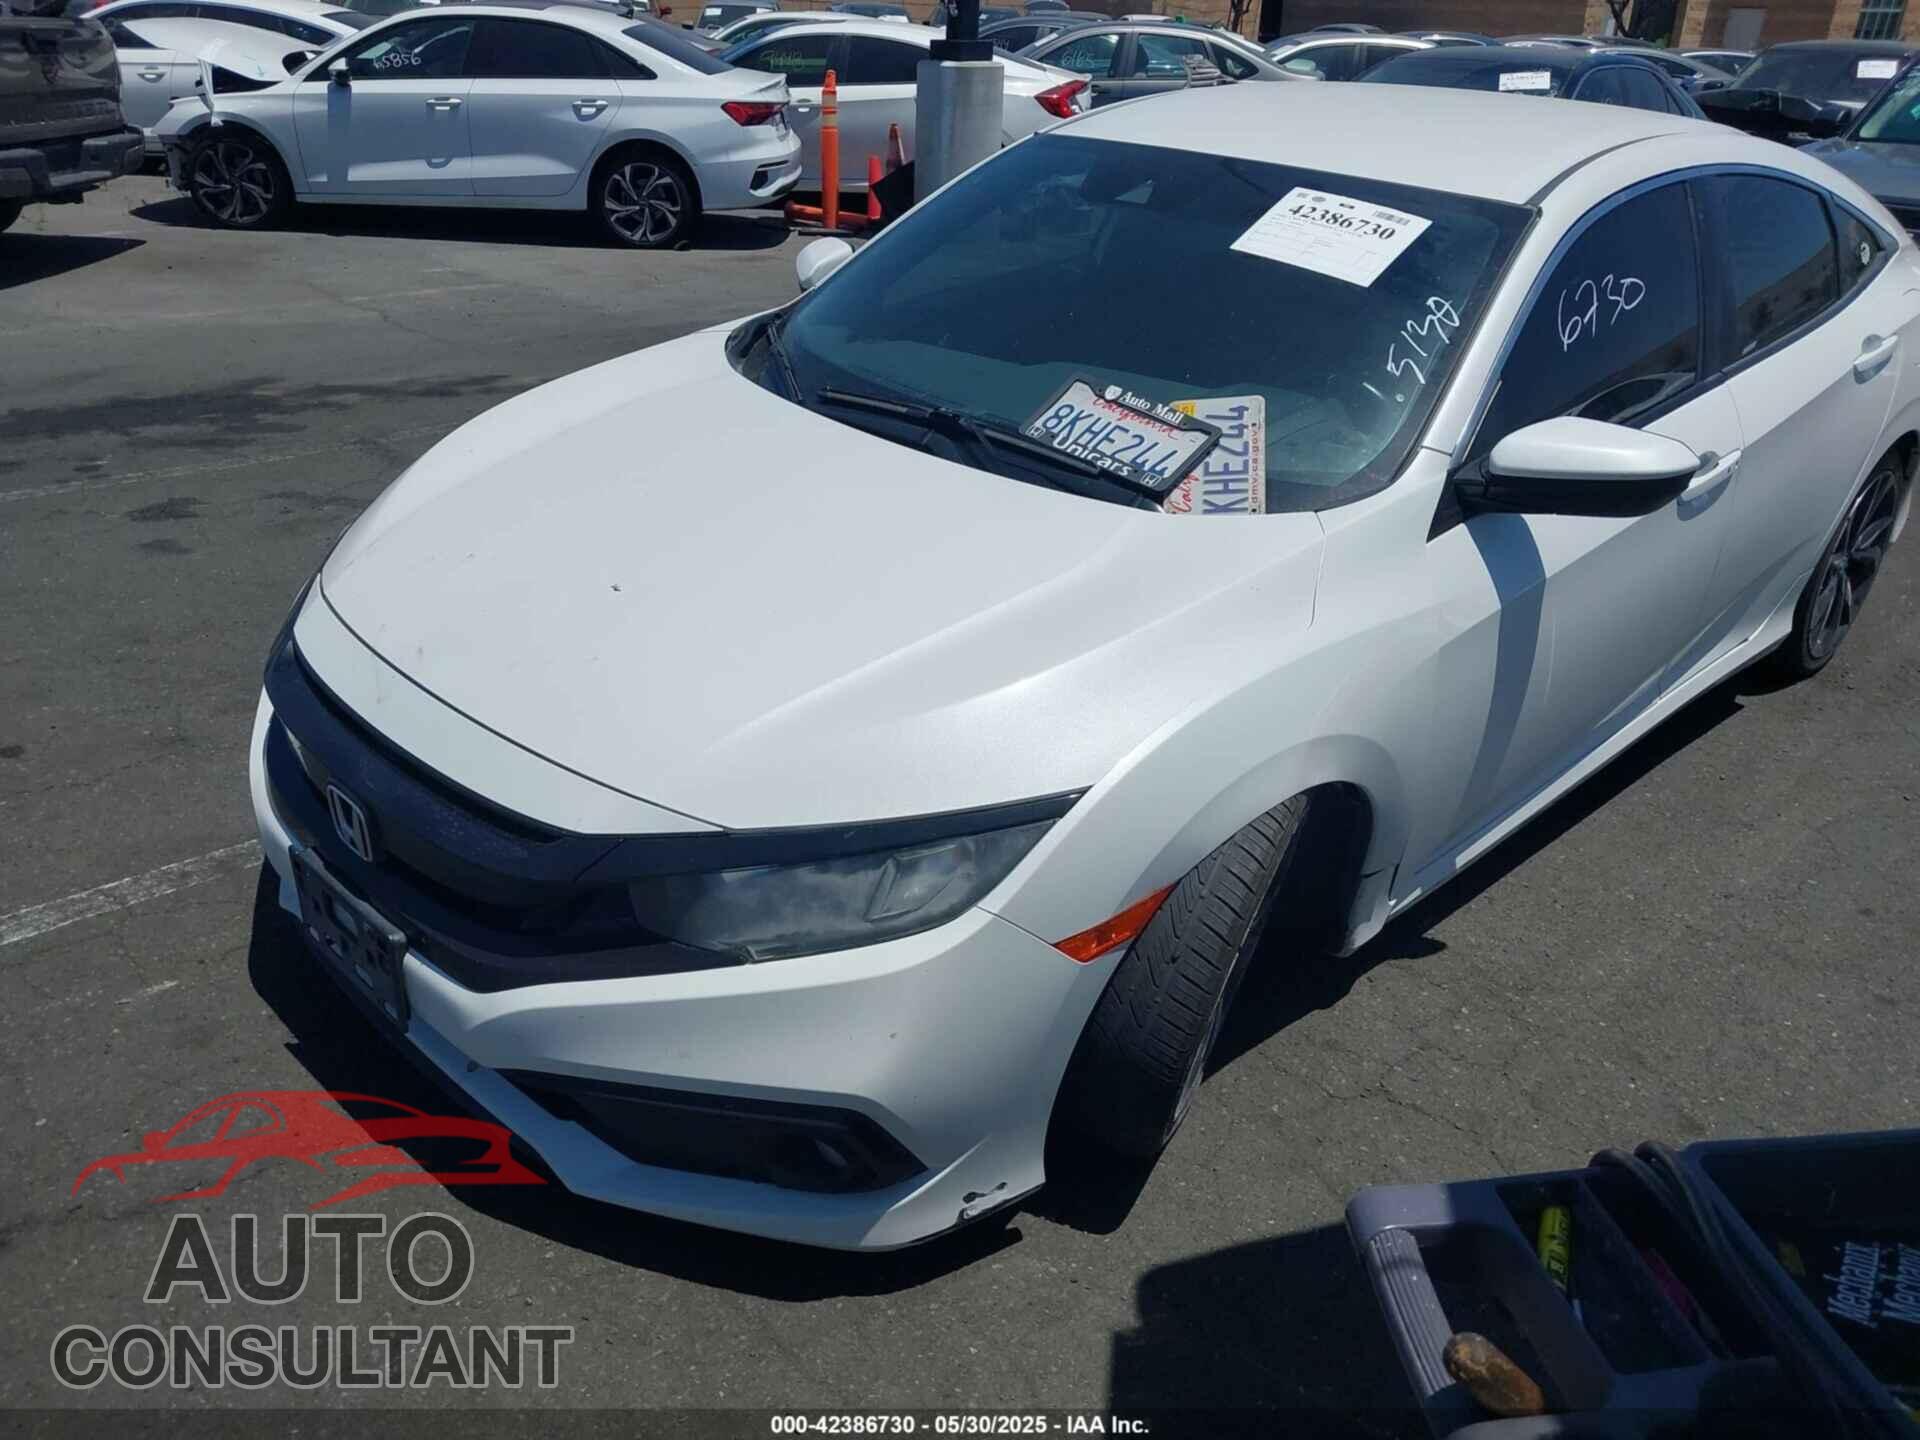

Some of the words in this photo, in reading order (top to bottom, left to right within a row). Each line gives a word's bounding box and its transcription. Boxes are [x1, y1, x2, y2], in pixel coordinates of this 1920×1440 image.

[1288, 203, 1396, 241] 42386730
[1558, 274, 1646, 352] 6730
[1119, 391, 1151, 411] Auto
[1152, 403, 1185, 425] Mall
[1043, 404, 1178, 479] 8KHE244
[1052, 433, 1133, 477] Unicars
